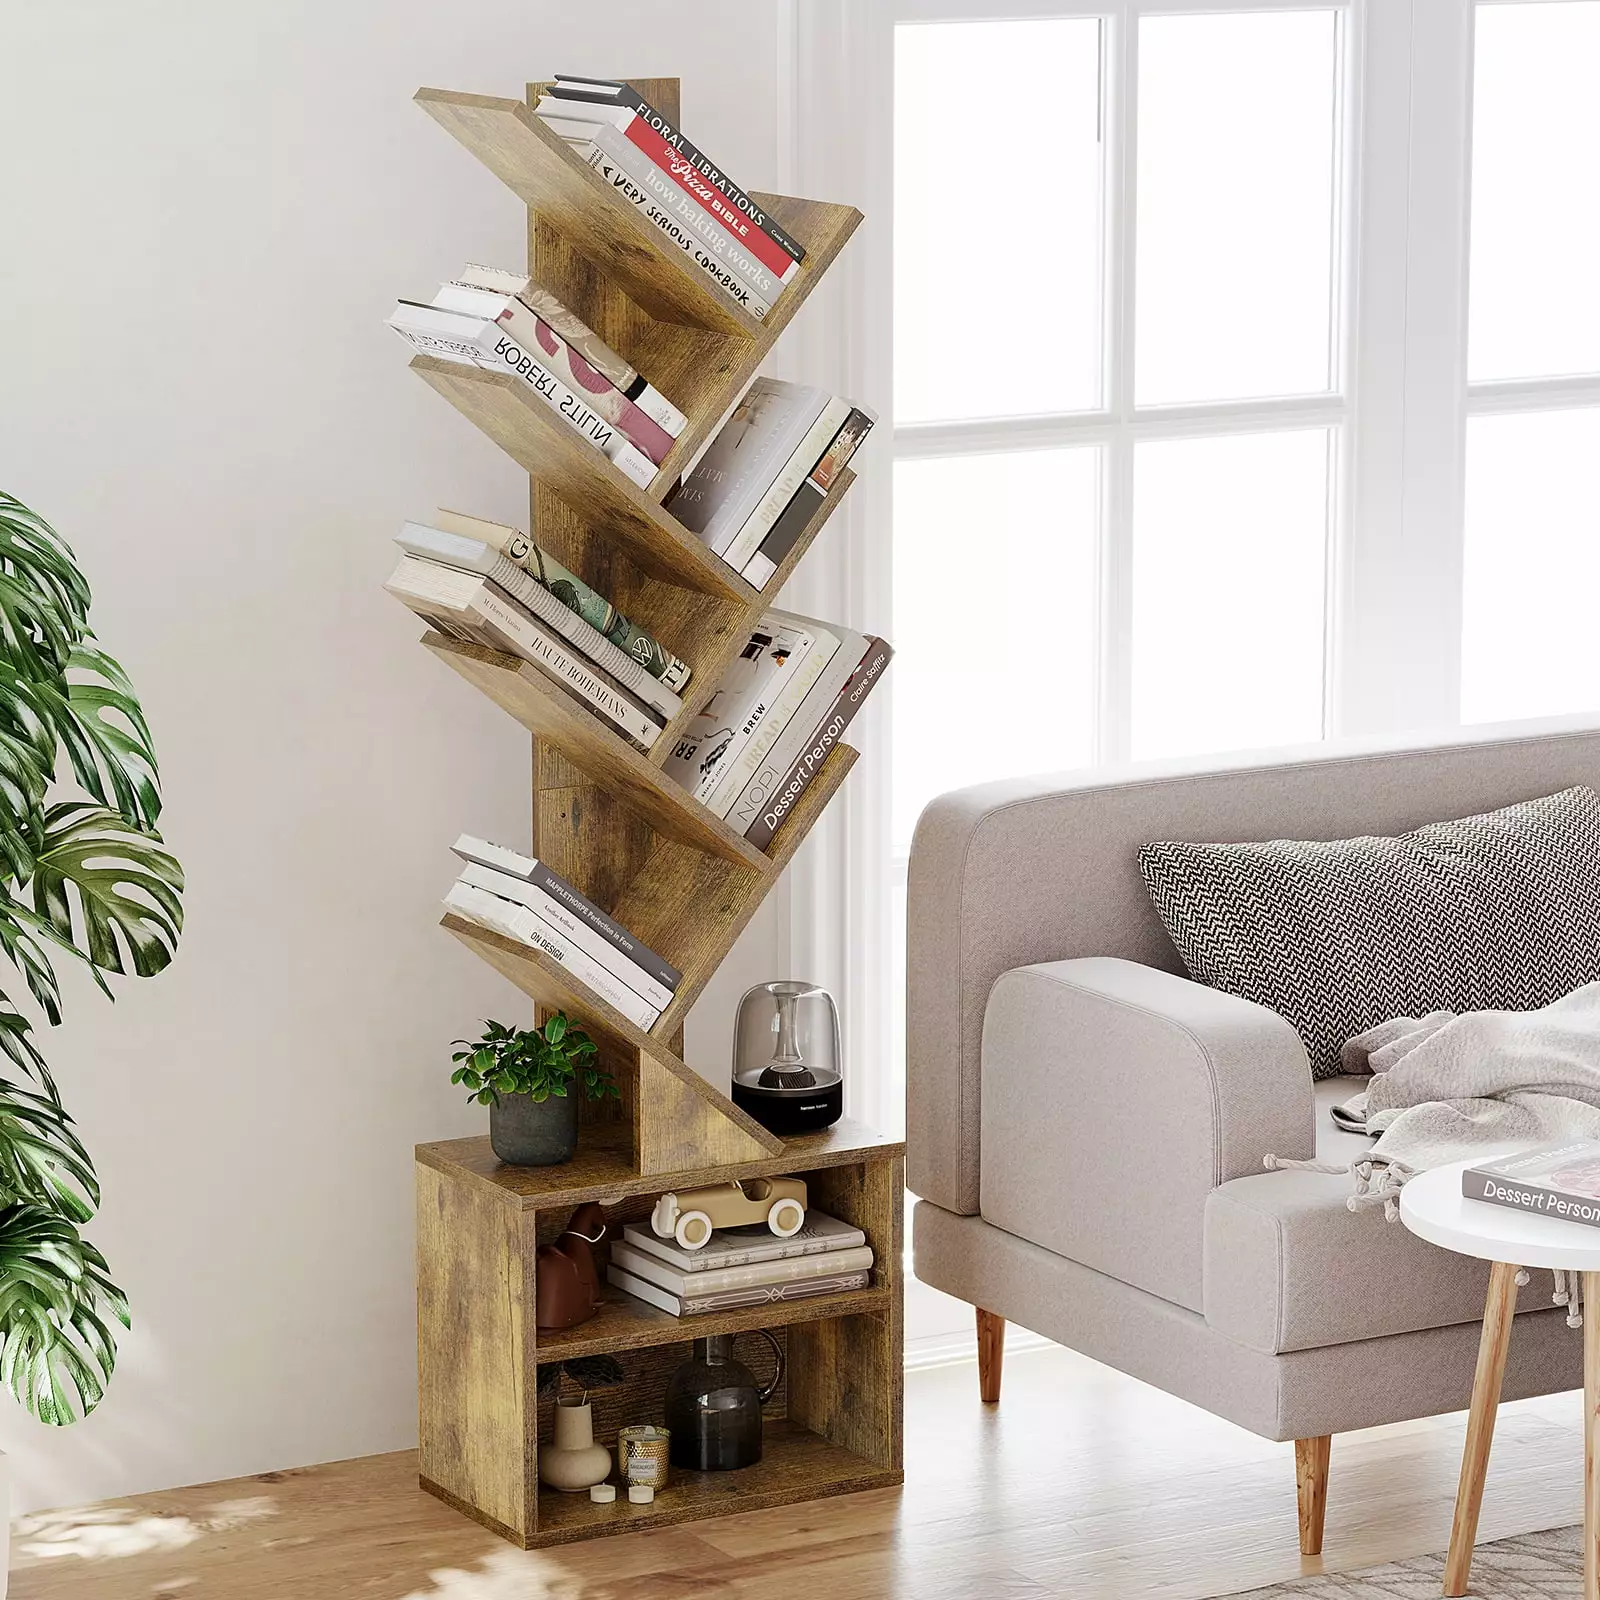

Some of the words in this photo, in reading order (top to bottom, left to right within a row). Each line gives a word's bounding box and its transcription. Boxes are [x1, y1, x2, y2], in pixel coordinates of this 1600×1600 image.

[636, 103, 684, 154] FLORAL
[689, 152, 766, 227] LIBRATIONS
[664, 146, 680, 165] The
[670, 159, 714, 203] Pizza
[603, 165, 613, 178] A
[613, 172, 646, 205] VERY
[646, 205, 692, 251] SERIOUS
[694, 250, 751, 306] COOKBOOK
[644, 167, 677, 204] how
[675, 198, 727, 252] baking
[727, 246, 772, 292] works
[711, 199, 749, 237] BIBLE
[531, 637, 566, 673] HAUTE
[566, 664, 628, 719] BOHEMIANS
[850, 678, 870, 703] Claire
[866, 653, 886, 679] Saffitz
[742, 702, 767, 735] BREW
[736, 765, 780, 823] NOPI
[763, 766, 809, 831] Dessert
[804, 714, 845, 771] Person
[545, 877, 588, 916] MAPPLETHORPE
[586, 910, 615, 936] Perfection
[612, 931, 621, 941] in
[618, 935, 634, 951] Form
[530, 931, 542, 945] ON
[540, 938, 565, 961] DESIGN
[1483, 1180, 1544, 1208] Dessert
[1546, 1194, 1600, 1222] Person
